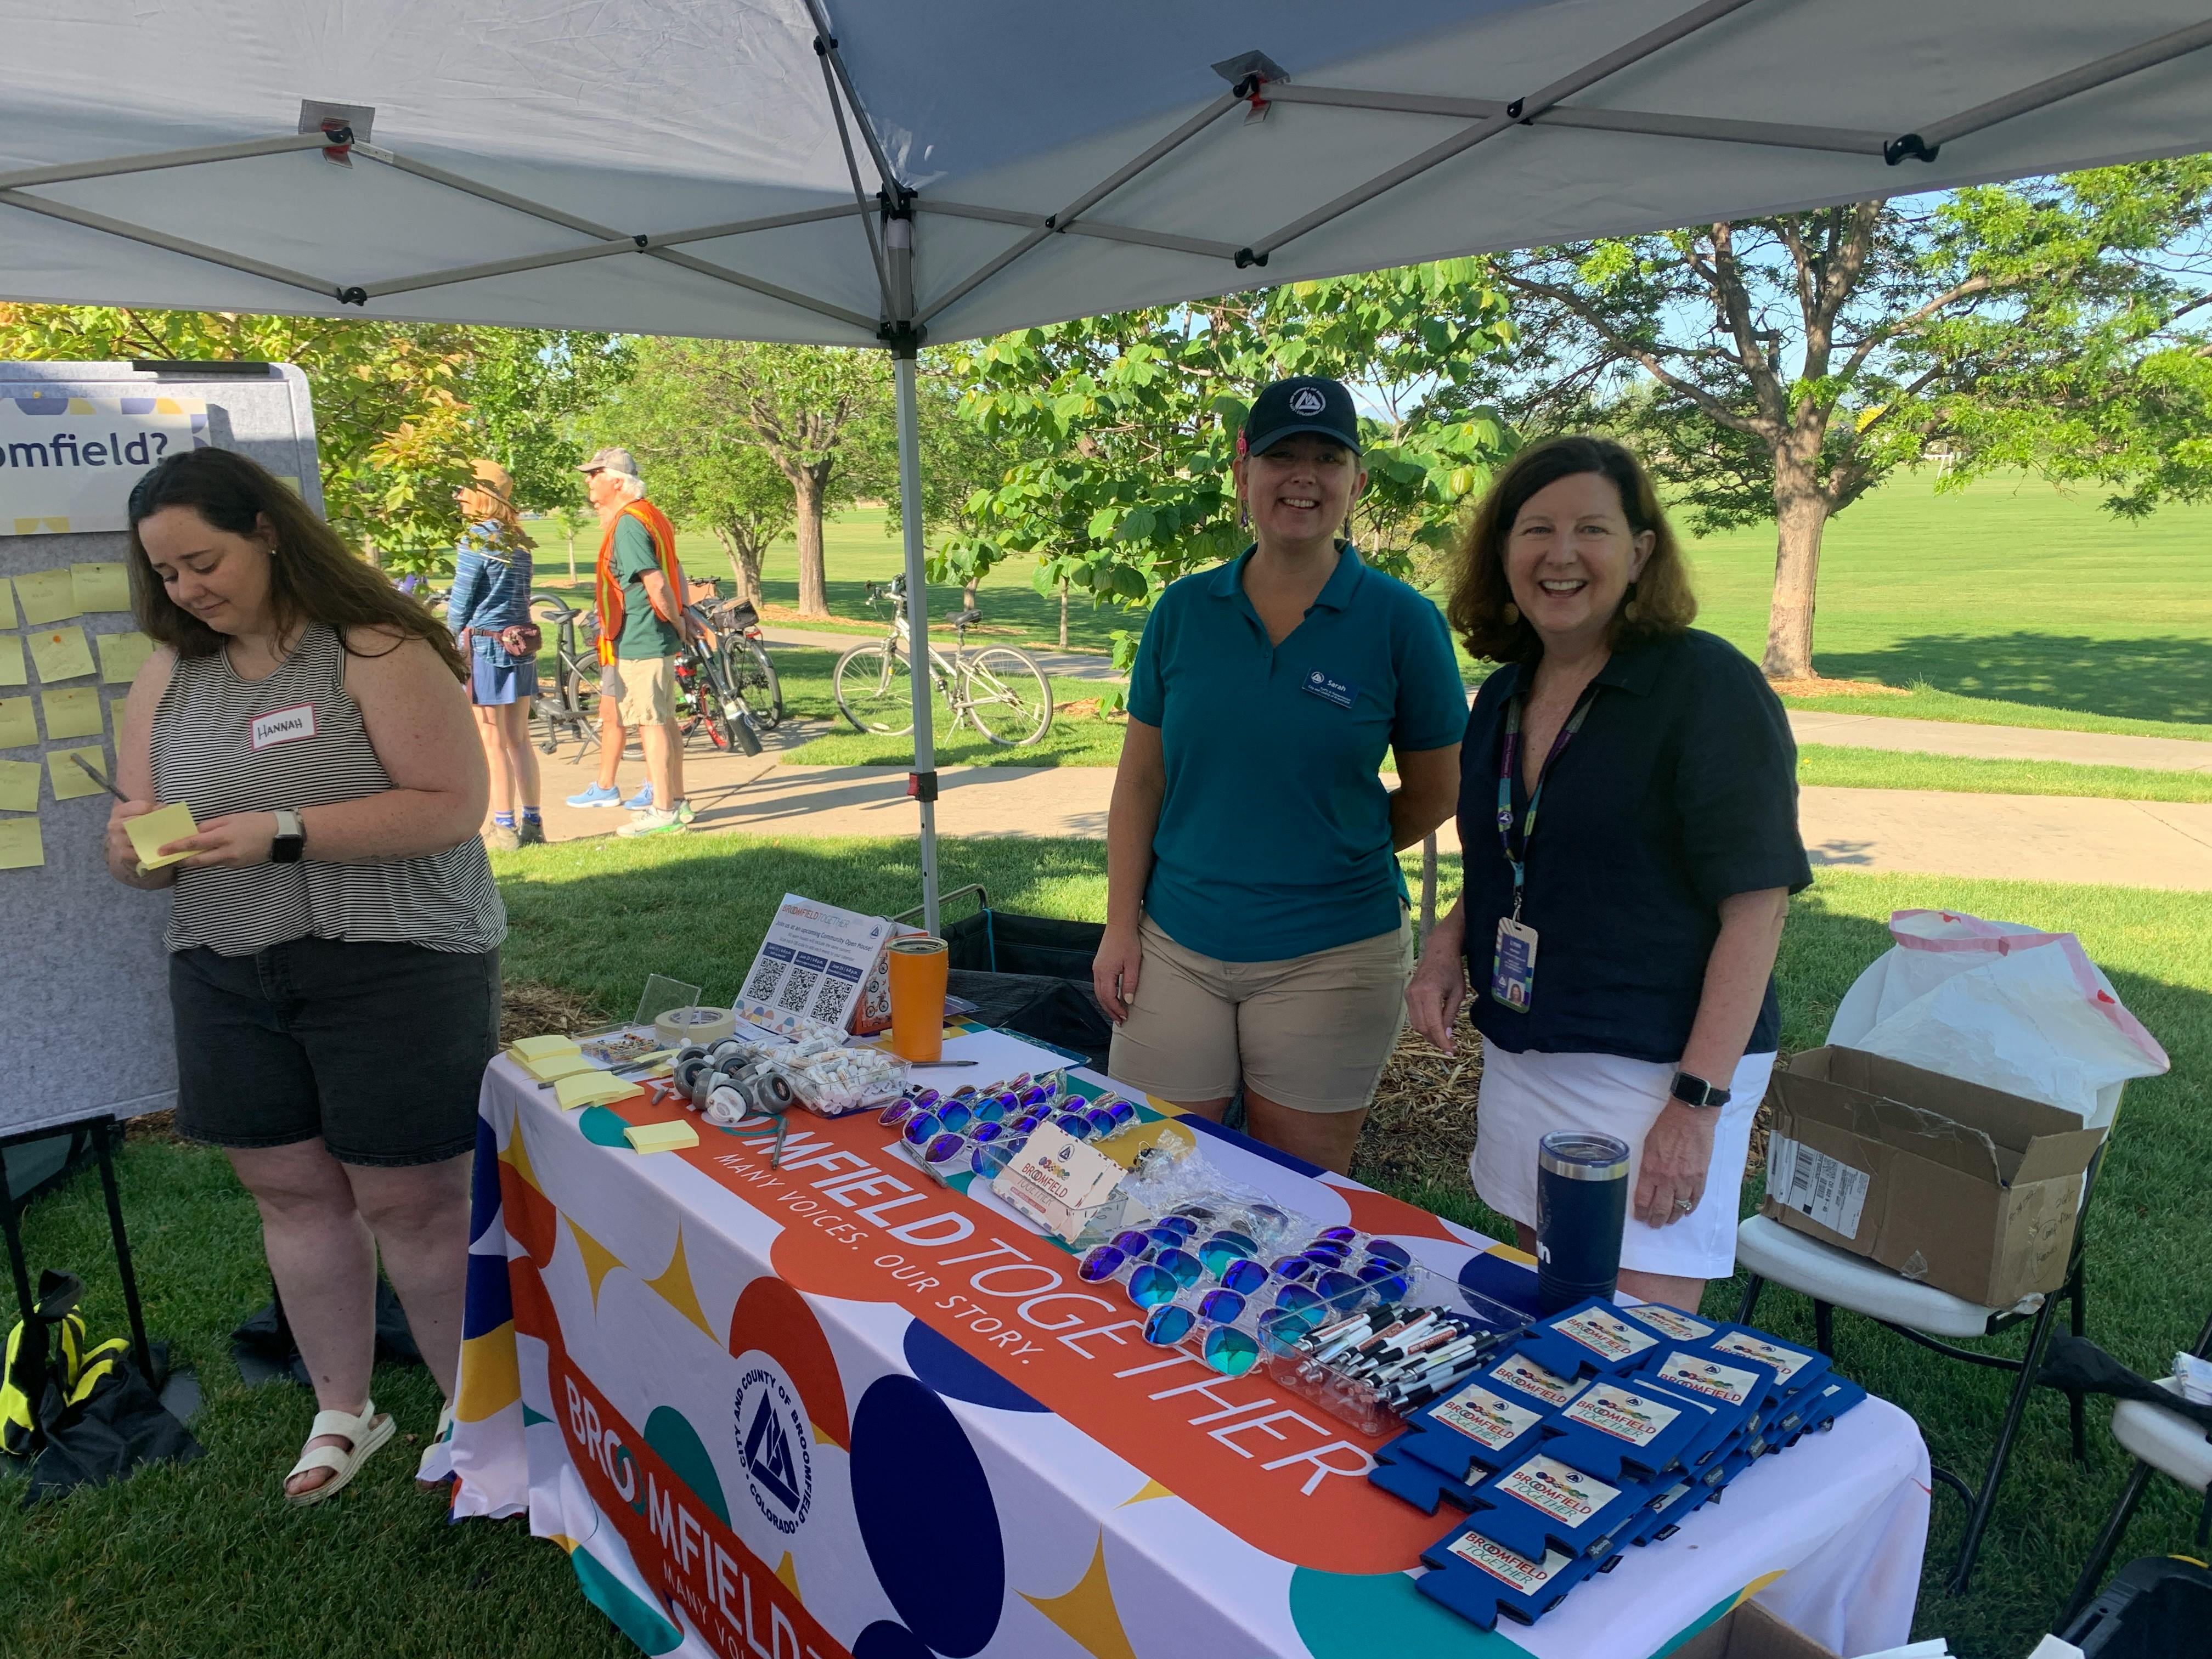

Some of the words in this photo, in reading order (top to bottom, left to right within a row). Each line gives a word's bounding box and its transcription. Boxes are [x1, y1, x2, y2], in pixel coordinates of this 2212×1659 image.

[0, 432, 168, 467] mfield?
[1327, 680, 1346, 692] Sarah
[257, 718, 302, 740] HANNAH
[801, 927, 823, 938] upcoming
[821, 933, 844, 944] Community
[845, 939, 856, 947] Open
[857, 943, 873, 952] House!
[1022, 1163, 1068, 1198] BROOMFIELD
[713, 1154, 785, 1188] MANY
[777, 1189, 869, 1250] VOICES.
[873, 1254, 940, 1293] OUR
[934, 1295, 1045, 1364] STORY.
[1567, 1318, 1631, 1354] BROOMFIELD
[742, 1369, 776, 1390] COUNTY
[937, 1238, 1380, 1496] TOGETHER
[778, 1386, 791, 1406] OF
[1496, 1368, 1567, 1403] BROOMFIELD
[733, 1388, 744, 1422] AND
[1445, 1401, 1514, 1438] BROOMFIELD
[1577, 1400, 1656, 1434] BROOMFIELD
[1577, 1408, 1644, 1437] TOGETHER
[1443, 1409, 1501, 1442] TOGETHER
[734, 1424, 747, 1469] CITY
[791, 1409, 812, 1524] BROOMFIELD
[749, 1483, 796, 1534] COLORADO
[1513, 1471, 1592, 1514] BROOMFIELD
[1513, 1481, 1577, 1517] TOGETHER
[565, 1374, 800, 1659] BROOMFIELD
[1465, 1533, 1548, 1580] BROOMFIELD
[1466, 1544, 1533, 1584] TOGETHER
[664, 1562, 707, 1625] MANY
